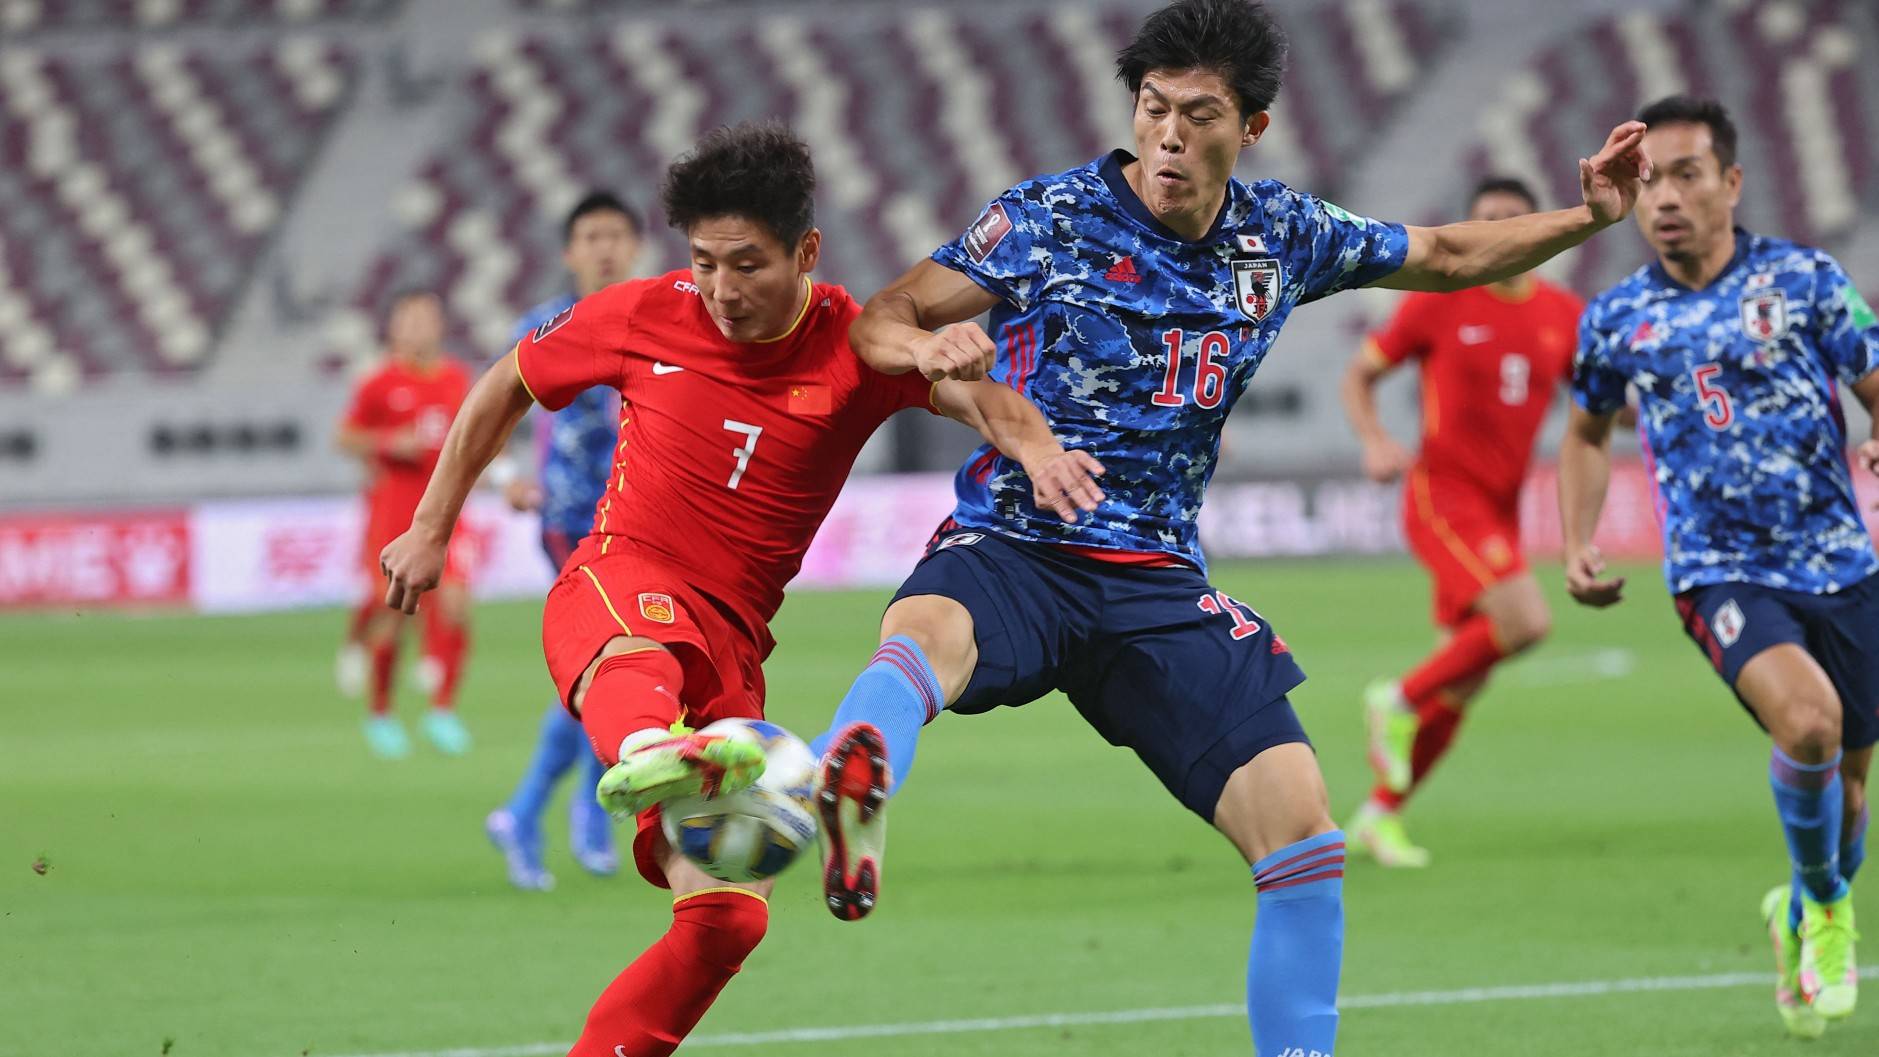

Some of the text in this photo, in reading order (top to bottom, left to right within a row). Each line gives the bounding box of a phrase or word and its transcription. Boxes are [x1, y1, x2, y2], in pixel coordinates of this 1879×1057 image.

[673, 279, 700, 296] CFA
[1151, 327, 1231, 410] 16
[1692, 360, 1736, 432] 5
[723, 418, 763, 490] 7
